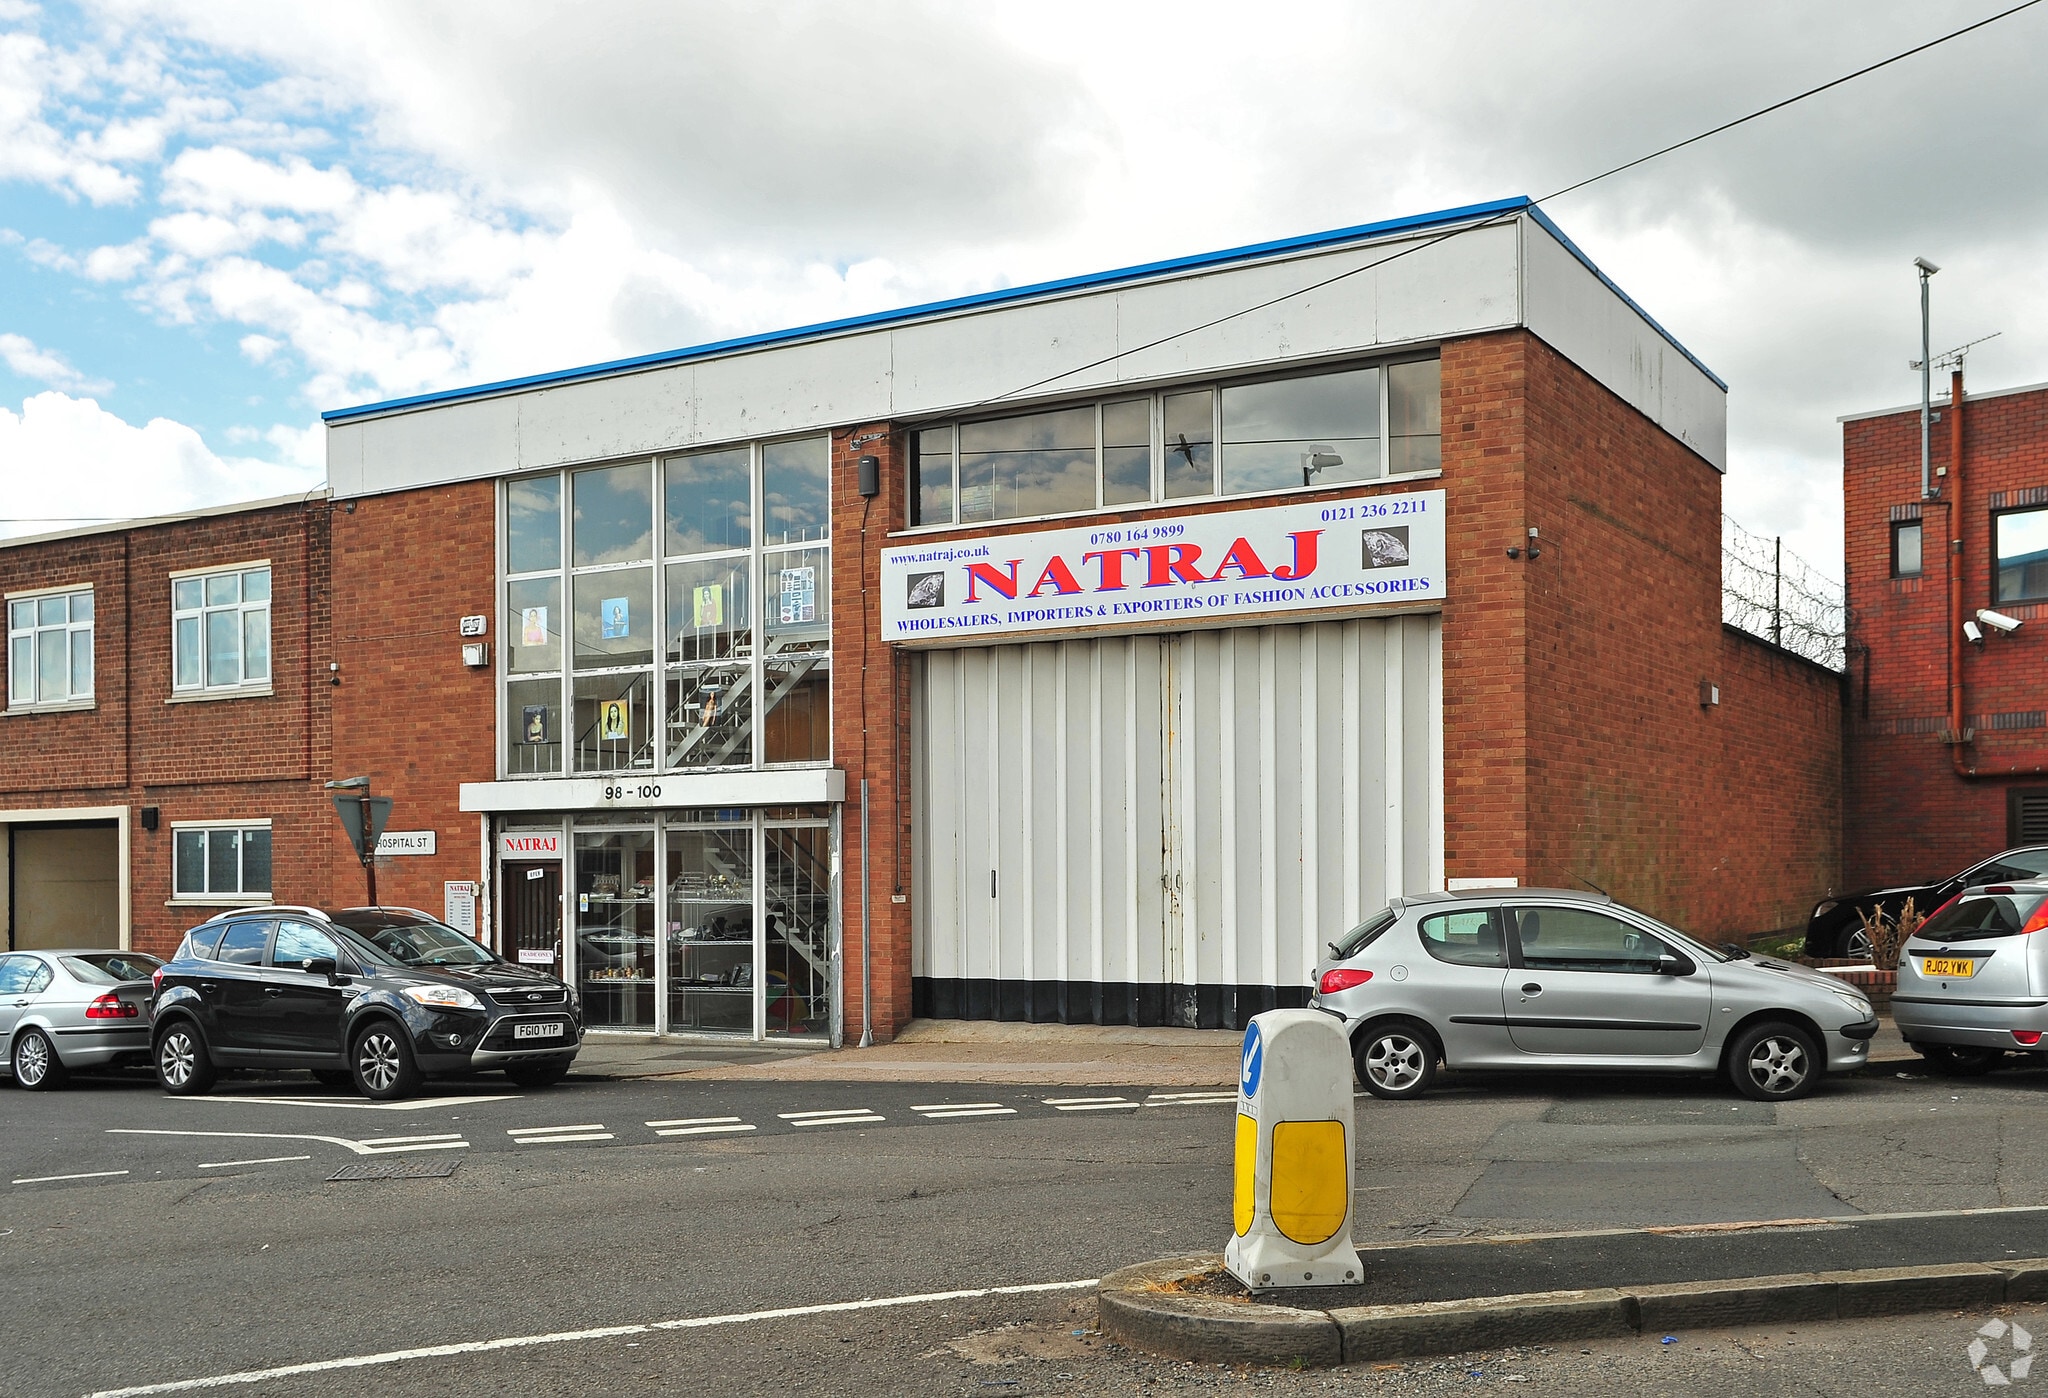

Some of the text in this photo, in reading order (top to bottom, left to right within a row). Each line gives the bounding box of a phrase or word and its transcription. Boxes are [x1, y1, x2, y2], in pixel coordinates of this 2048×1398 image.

[1321, 499, 1427, 522] 0121 236 2211
[1090, 524, 1185, 545] 0780 164 9899
[891, 545, 990, 565] www.natraj.co.uk
[961, 529, 1326, 605] NATRAJ
[897, 577, 1430, 632] WHOLESALERS, IMPORTERS & EXPORTERS OF FASHION ACCESSORIES
[605, 786, 622, 799] 98
[637, 785, 662, 798] 100
[417, 837, 427, 848] ST
[505, 837, 557, 852] NATRAJ
[1926, 960, 1969, 974] RJ02 YWK
[520, 1024, 559, 1036] FG10 YTP
